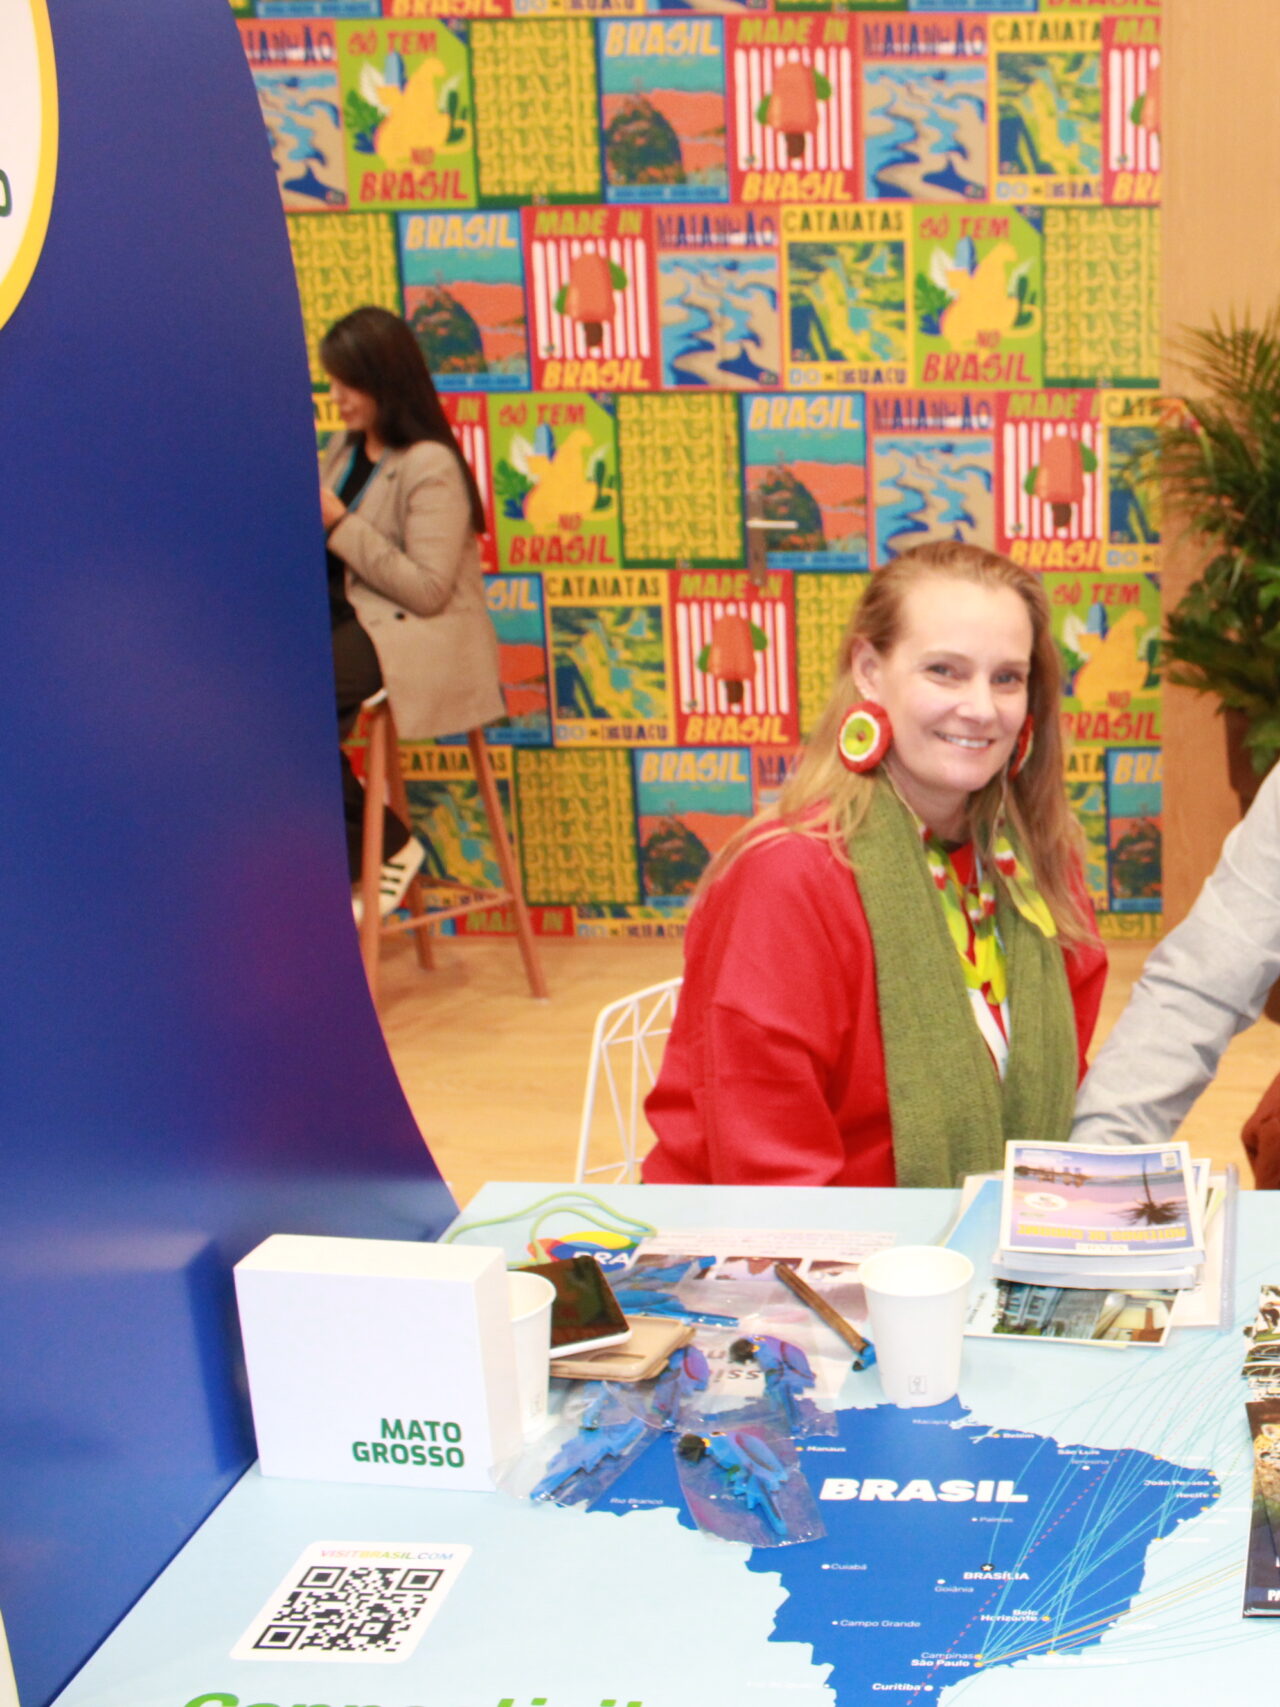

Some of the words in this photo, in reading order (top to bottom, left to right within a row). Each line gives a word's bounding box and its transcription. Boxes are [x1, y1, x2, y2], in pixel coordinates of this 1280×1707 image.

[604, 22, 720, 57] BRASIL
[737, 19, 813, 45] MADE
[359, 170, 470, 203] BRASIL
[741, 171, 853, 202] BRASIL
[404, 214, 518, 250] BRASIL
[533, 210, 608, 237] MADE
[541, 359, 651, 390] BRASIL
[921, 352, 1033, 384] BRASIL
[748, 396, 863, 431] BRASIL
[508, 535, 615, 567] BRASIL
[685, 715, 790, 745] BRASIL
[639, 752, 747, 783] BRASIL
[380, 1418, 463, 1443] MATO
[351, 1441, 465, 1468] GROSSO
[819, 1478, 1029, 1503] BRASIL
[318, 1548, 454, 1561] VISITBRASIL.COM
[962, 1570, 1030, 1581] BRASÍLIA
[840, 1619, 878, 1629] Campo
[880, 1619, 921, 1628] Grande
[872, 1682, 922, 1692] Curitiba
